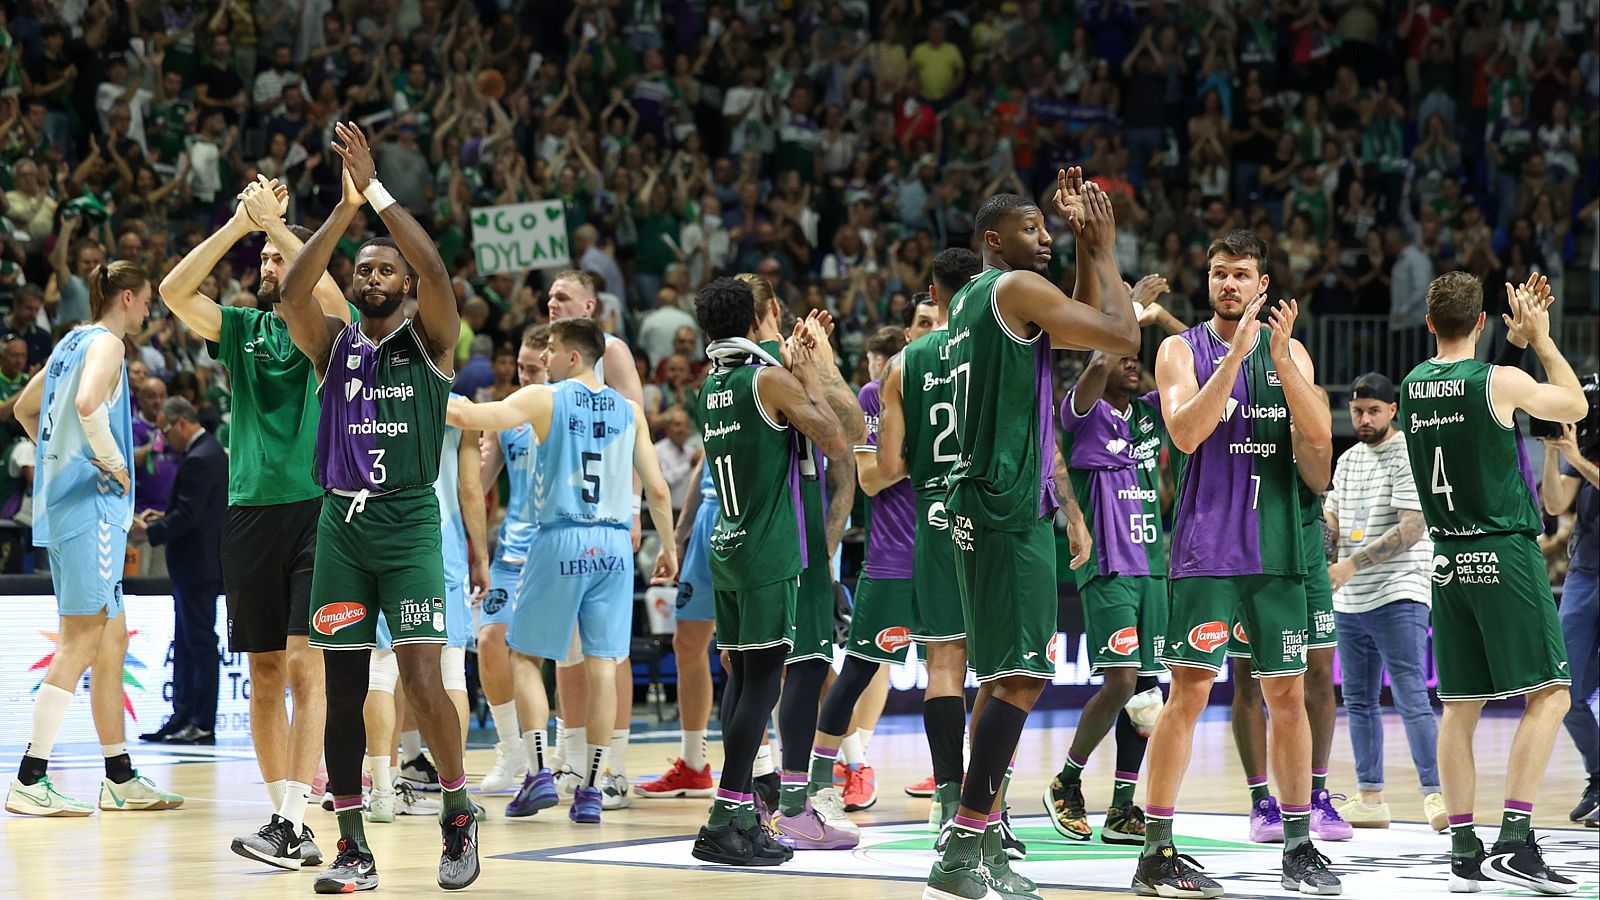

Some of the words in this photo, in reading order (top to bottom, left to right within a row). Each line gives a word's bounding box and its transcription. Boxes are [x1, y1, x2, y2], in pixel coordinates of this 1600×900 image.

[475, 234, 565, 274] DYLAN
[362, 383, 414, 402] Unicaja
[1408, 379, 1465, 400] KALINOSKI
[348, 417, 409, 437] málaga
[1229, 437, 1276, 458] máaga
[367, 448, 387, 485] 3
[581, 451, 602, 505] 5
[715, 454, 740, 517] 11
[1431, 446, 1454, 512] 4
[1250, 474, 1261, 510] 7
[1129, 513, 1157, 544] 55
[560, 555, 625, 576] LEBANZA
[1455, 552, 1500, 564] COSTA
[1456, 566, 1475, 575] DEL
[1476, 565, 1500, 574] SOL
[1458, 574, 1500, 585] MÁLAGA
